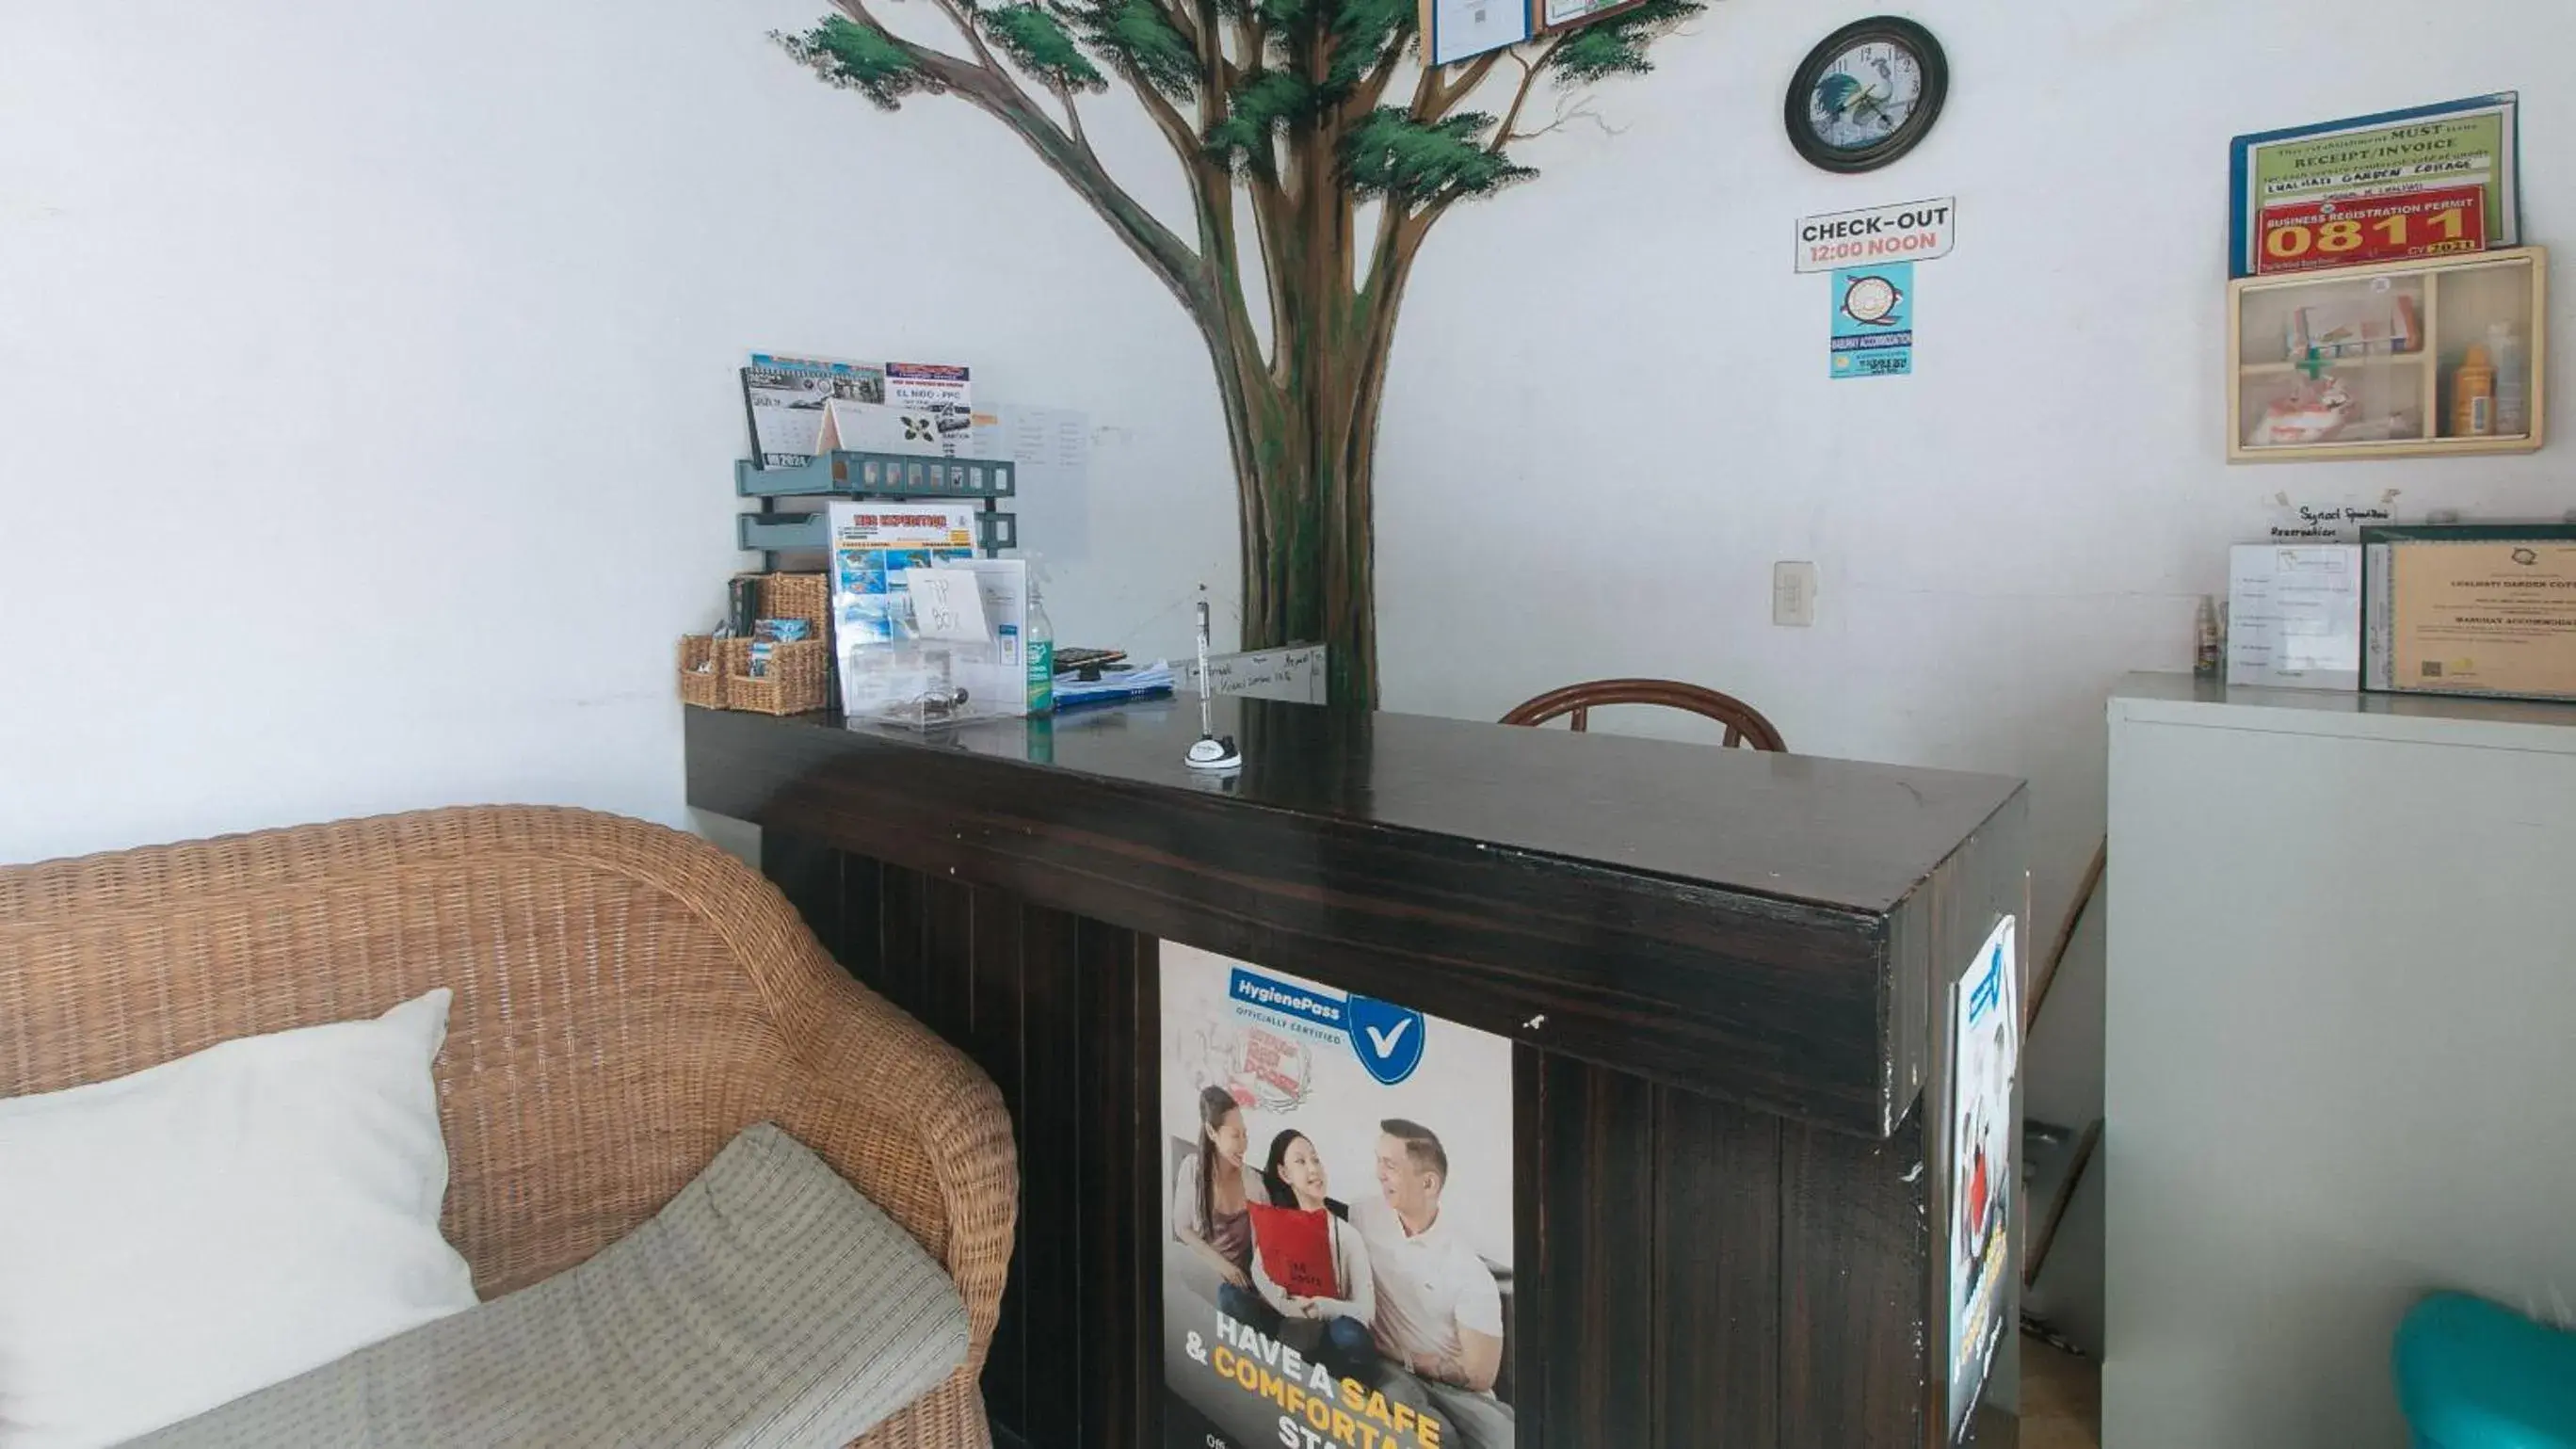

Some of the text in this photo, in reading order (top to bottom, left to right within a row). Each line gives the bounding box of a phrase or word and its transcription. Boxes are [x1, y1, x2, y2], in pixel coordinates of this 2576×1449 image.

[2391, 124, 2443, 139] MUST
[2294, 138, 2455, 169] RECEIPT/INVOICE
[2342, 169, 2401, 183] GARDEN
[1802, 206, 1949, 242] CHECK-OUT
[2267, 199, 2474, 229] BUSINESS REGISTRATION PERMIT
[1811, 232, 1937, 263] 12:00 NOON
[2266, 209, 2463, 257] 0811
[1238, 979, 1340, 1021] HygienePass
[1236, 1006, 1287, 1029] OFFICIALLY
[1291, 1022, 1341, 1045] CERTIFIED
[1185, 1330, 1209, 1366] &
[1216, 1310, 1441, 1449] HAVE A SAFE
